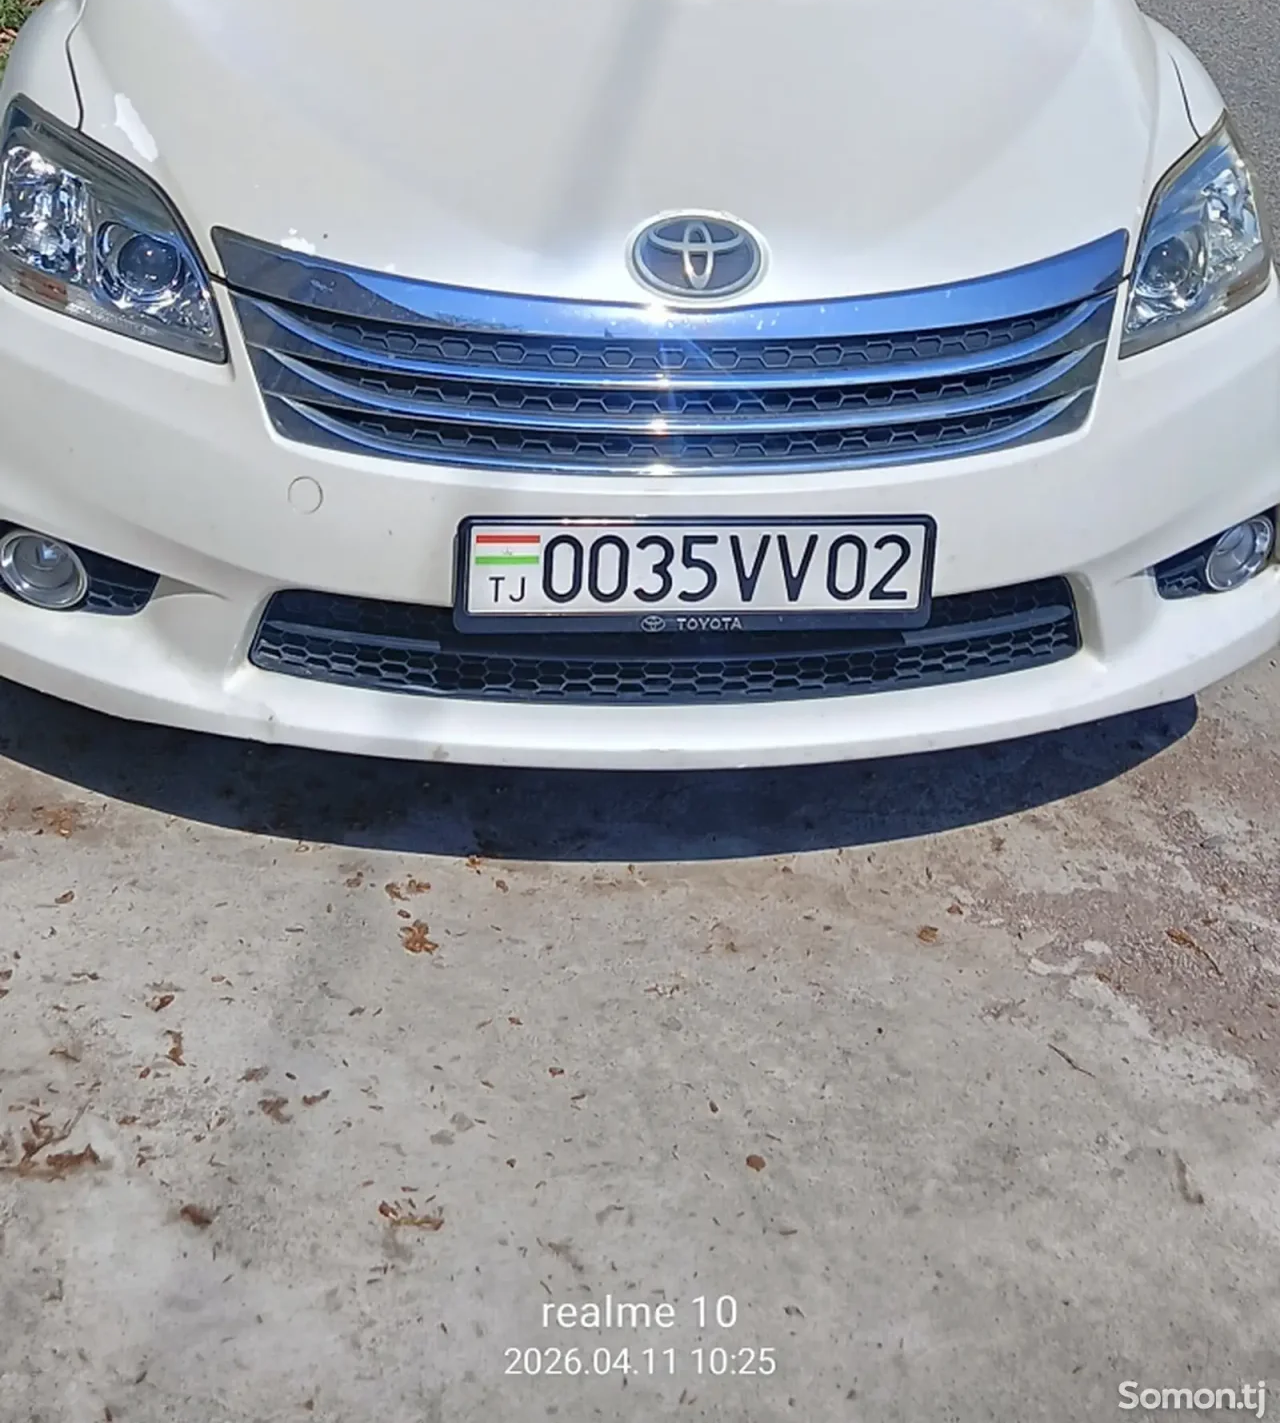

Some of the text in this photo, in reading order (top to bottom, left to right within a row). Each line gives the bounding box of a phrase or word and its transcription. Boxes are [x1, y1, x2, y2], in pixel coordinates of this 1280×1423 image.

[542, 534, 911, 604] 0035VV02
[488, 576, 526, 603] TJ
[676, 616, 743, 631] TOYOTA
